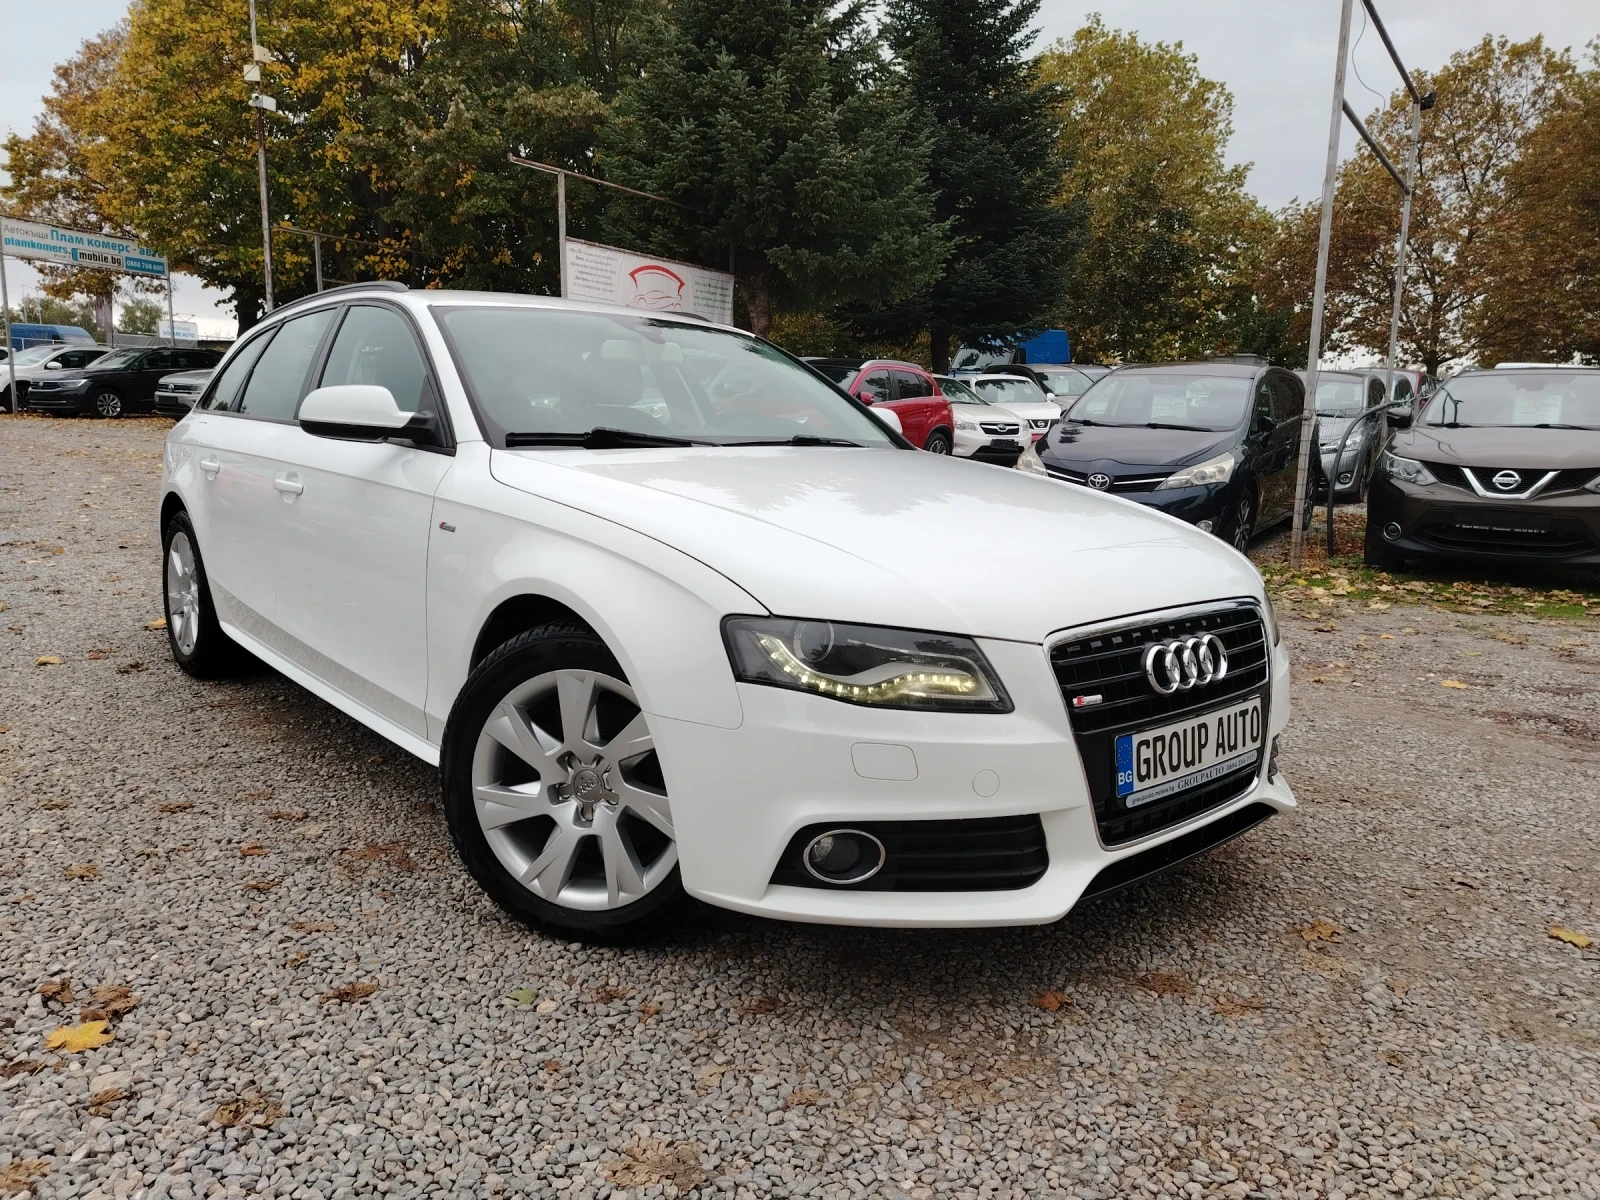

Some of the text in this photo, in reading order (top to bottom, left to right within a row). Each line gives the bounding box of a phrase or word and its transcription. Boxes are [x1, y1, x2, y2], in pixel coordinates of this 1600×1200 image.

[4, 224, 49, 240] Автокъща
[50, 229, 84, 245] Плам
[87, 238, 130, 254] комерс
[138, 246, 163, 259] ав
[79, 251, 121, 266] mobile.bg
[1135, 705, 1261, 783] GROUP AUTO
[1118, 770, 1133, 786] BG
[1177, 765, 1225, 790] GROUPAUTO
